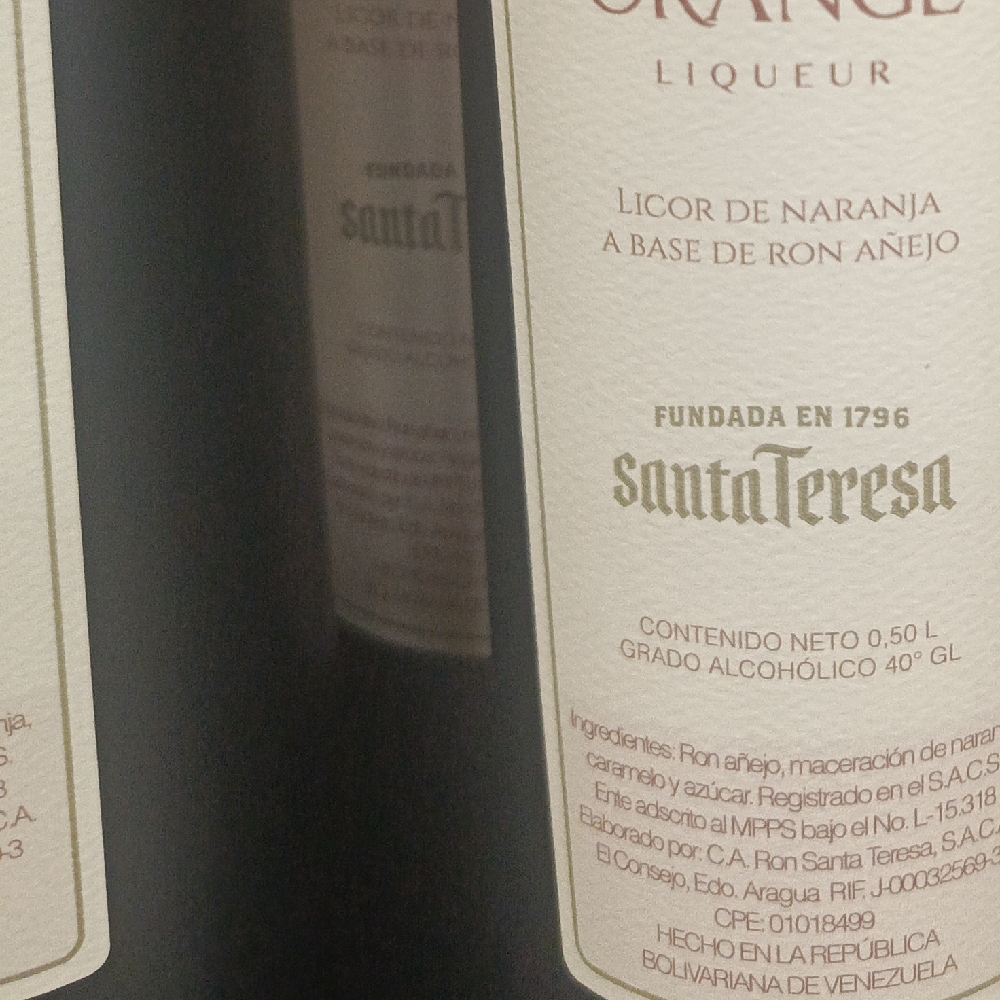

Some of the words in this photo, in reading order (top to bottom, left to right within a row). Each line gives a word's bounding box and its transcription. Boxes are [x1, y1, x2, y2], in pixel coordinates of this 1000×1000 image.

[656, 59, 892, 94] LIQUEUR
[617, 187, 714, 222] LICOR
[725, 198, 770, 224] DE
[780, 190, 942, 224] NARANJA
[602, 230, 621, 254] A
[630, 232, 701, 264] BASE
[712, 240, 756, 266] DE
[768, 239, 843, 267] RON
[854, 229, 961, 263] AÑEJO
[654, 405, 786, 428] FUNDADA
[796, 405, 833, 428] EN
[844, 406, 910, 429] 1796
[640, 615, 782, 652] CONTENIDO
[790, 630, 860, 653] NETO
[867, 623, 918, 650] 0,50
[925, 620, 939, 640] L
[619, 637, 701, 673] GRADO
[708, 655, 877, 681] ALCOHÓLICO
[885, 649, 923, 677] 40°
[930, 642, 962, 666] GL
[569, 707, 676, 761] Ingredientes:
[679, 742, 720, 769] Ron
[724, 752, 785, 779] añejo,
[790, 747, 915, 775] maceración
[919, 739, 947, 762] de
[587, 751, 665, 790] caramelo
[669, 776, 680, 797] y
[684, 780, 754, 806] azúcar.
[758, 785, 873, 813] Registrado
[876, 784, 903, 801] en
[907, 773, 924, 796] el
[595, 780, 632, 811] Ente
[635, 800, 707, 831] adscrito
[710, 814, 727, 834] al
[731, 815, 797, 840] MPPS
[801, 819, 847, 844] bajo
[851, 816, 869, 837] el
[873, 812, 909, 835] No.
[914, 786, 997, 828] L-15.318
[579, 803, 665, 852] Elaborado
[668, 838, 703, 862] por:
[754, 850, 798, 871] Ron
[802, 850, 863, 872] Santa
[866, 841, 937, 867] Teresa,
[596, 841, 611, 865] El
[613, 850, 690, 893] Consejo,
[694, 872, 739, 898] Edo.
[743, 880, 820, 908] Aragua
[769, 910, 876, 934] 01018499
[656, 923, 735, 960] HECHO
[739, 941, 772, 963] EN
[775, 944, 807, 965] LA
[810, 928, 941, 965] REPÚBLICA
[642, 948, 784, 995] BOLIVARIANA
[787, 975, 820, 996] DE
[824, 953, 959, 995] VENEZUELA
